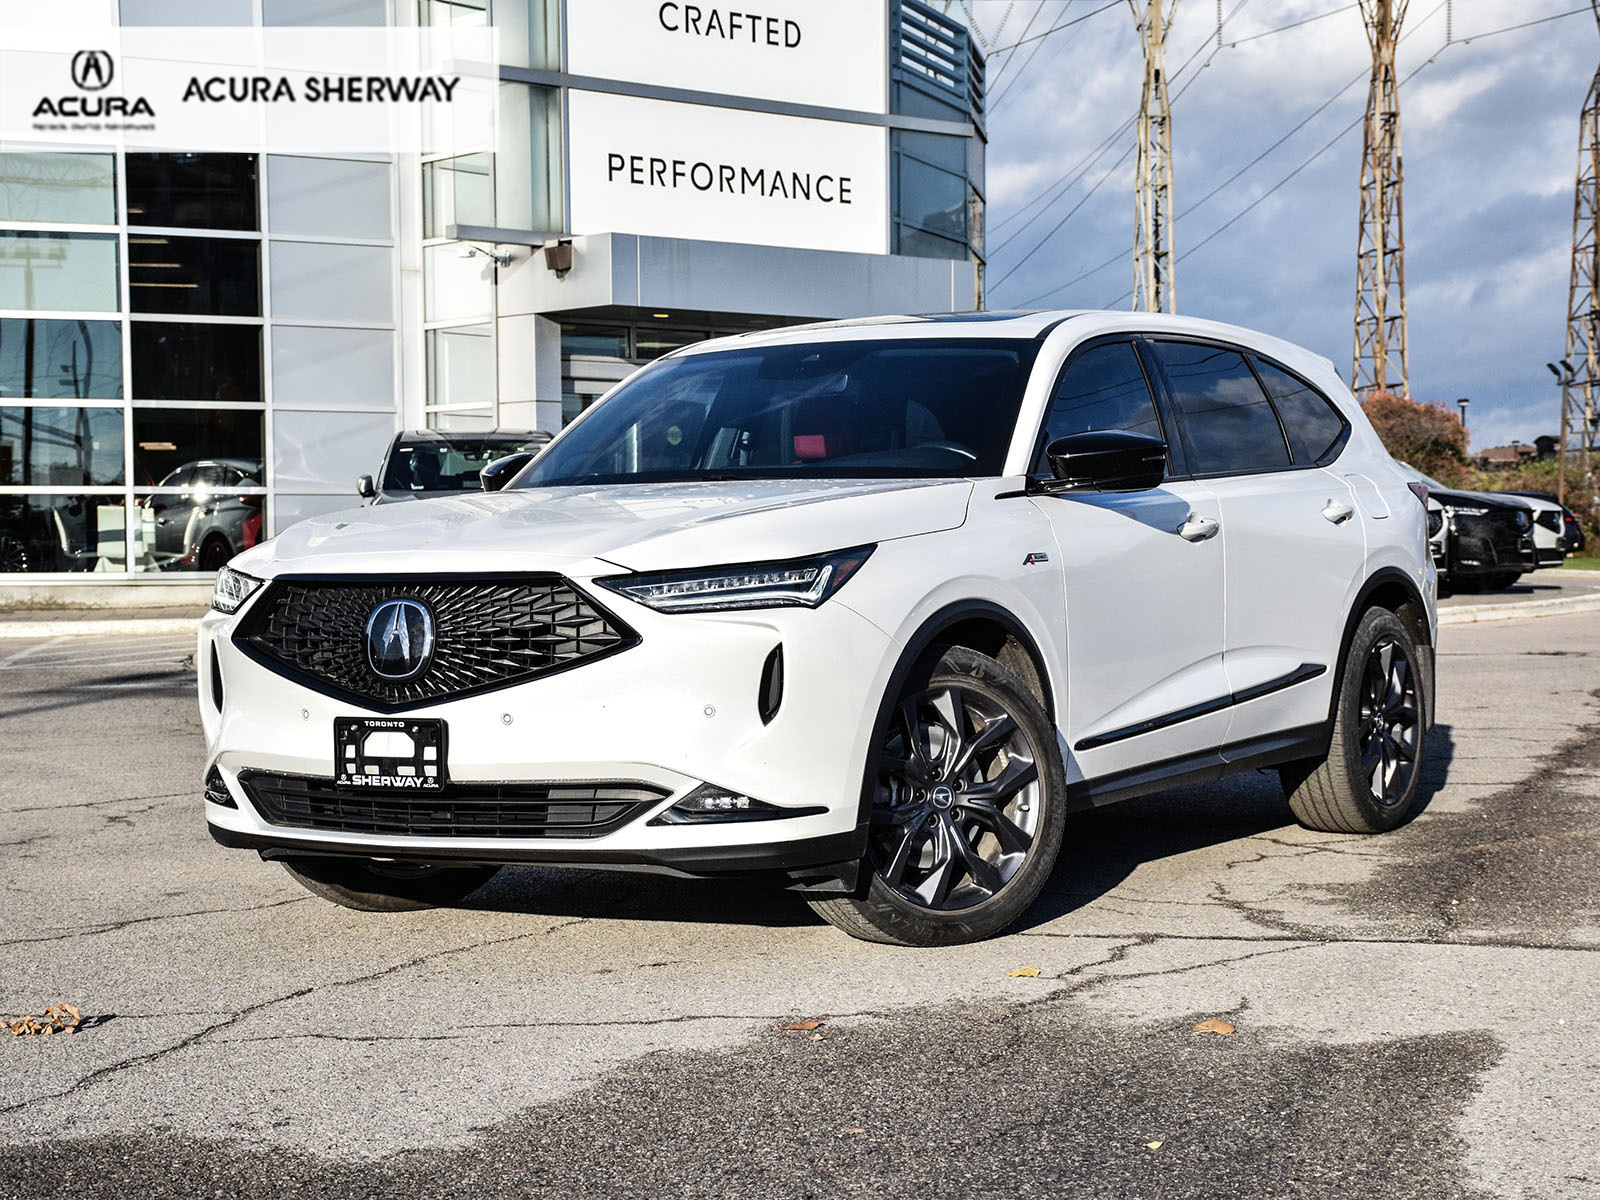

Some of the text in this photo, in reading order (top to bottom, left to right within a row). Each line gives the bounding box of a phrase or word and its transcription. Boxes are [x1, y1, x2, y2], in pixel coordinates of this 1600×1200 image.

[659, 2, 801, 48] CRAFTED
[609, 154, 851, 204] PERFORMANCE
[352, 775, 424, 787] SHERWAY
